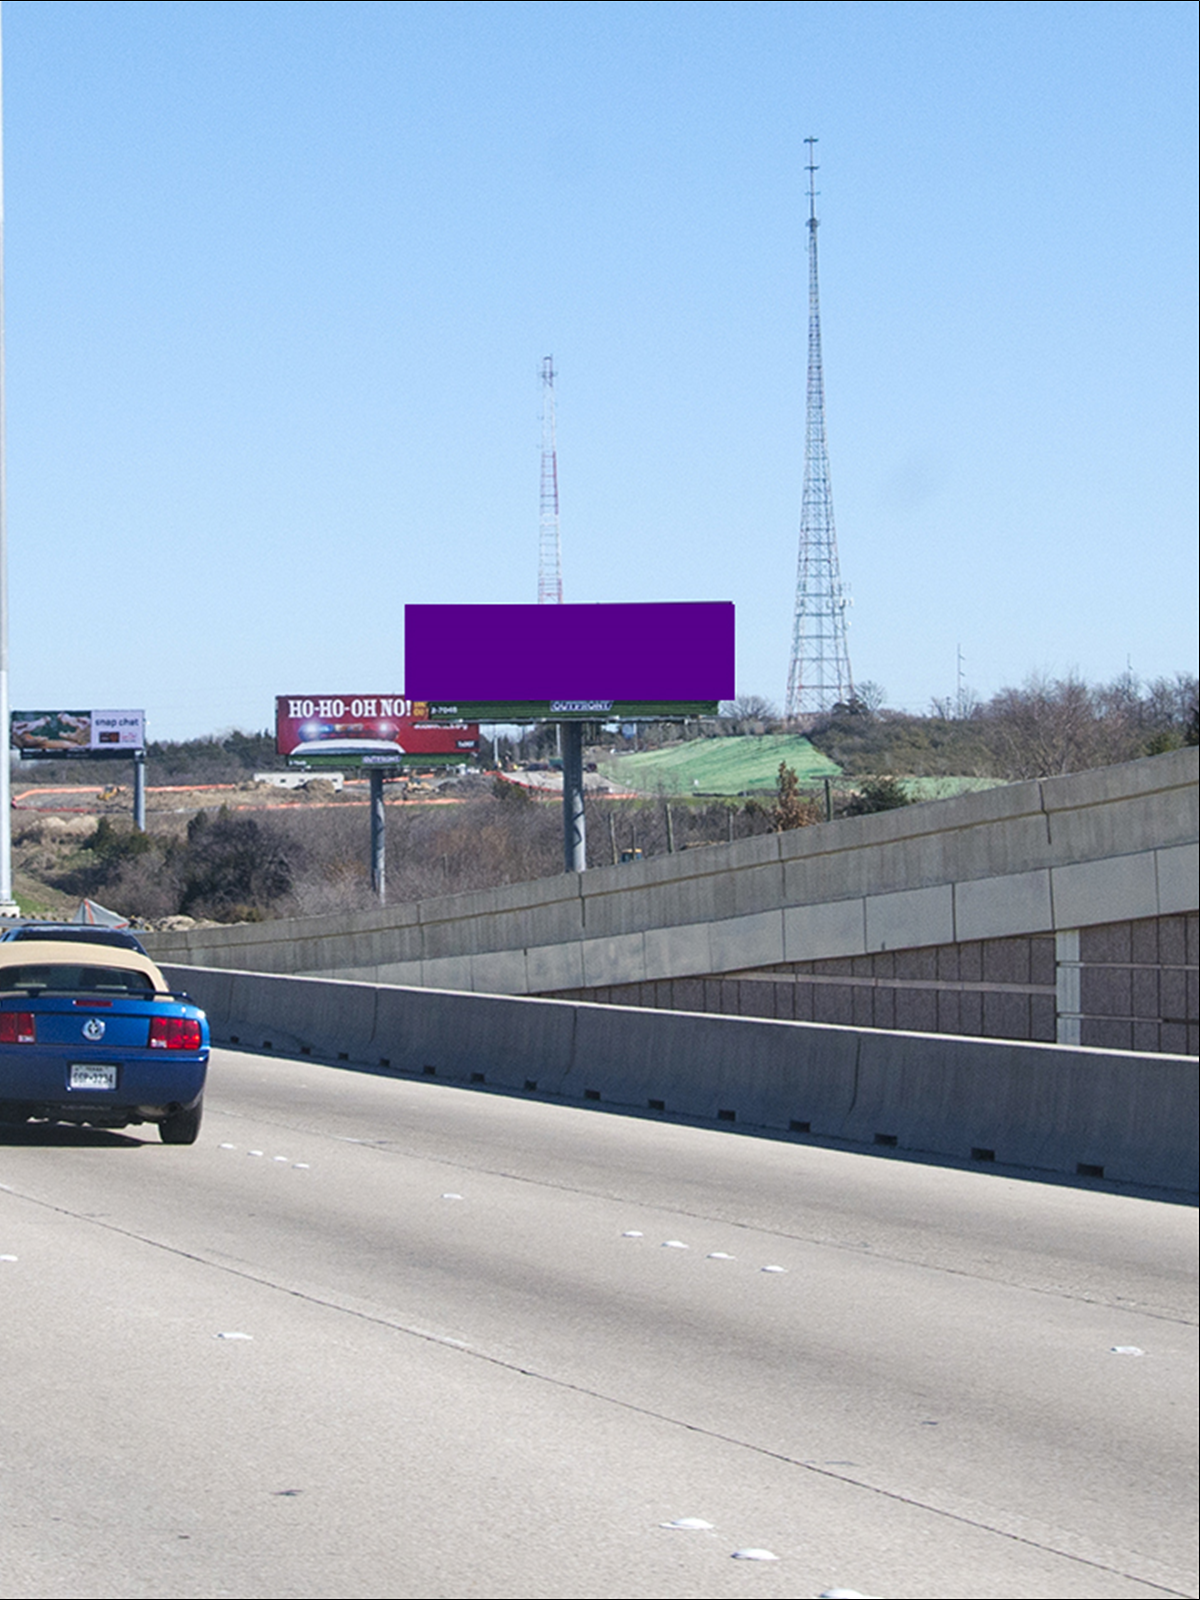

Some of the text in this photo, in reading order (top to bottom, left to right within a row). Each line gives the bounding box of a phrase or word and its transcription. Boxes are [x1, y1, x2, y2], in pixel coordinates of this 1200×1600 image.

[288, 700, 377, 718] HO-HO-OH
[380, 700, 412, 717] NO!
[551, 701, 611, 711] OUTFRONT
[95, 718, 139, 728] snap chat
